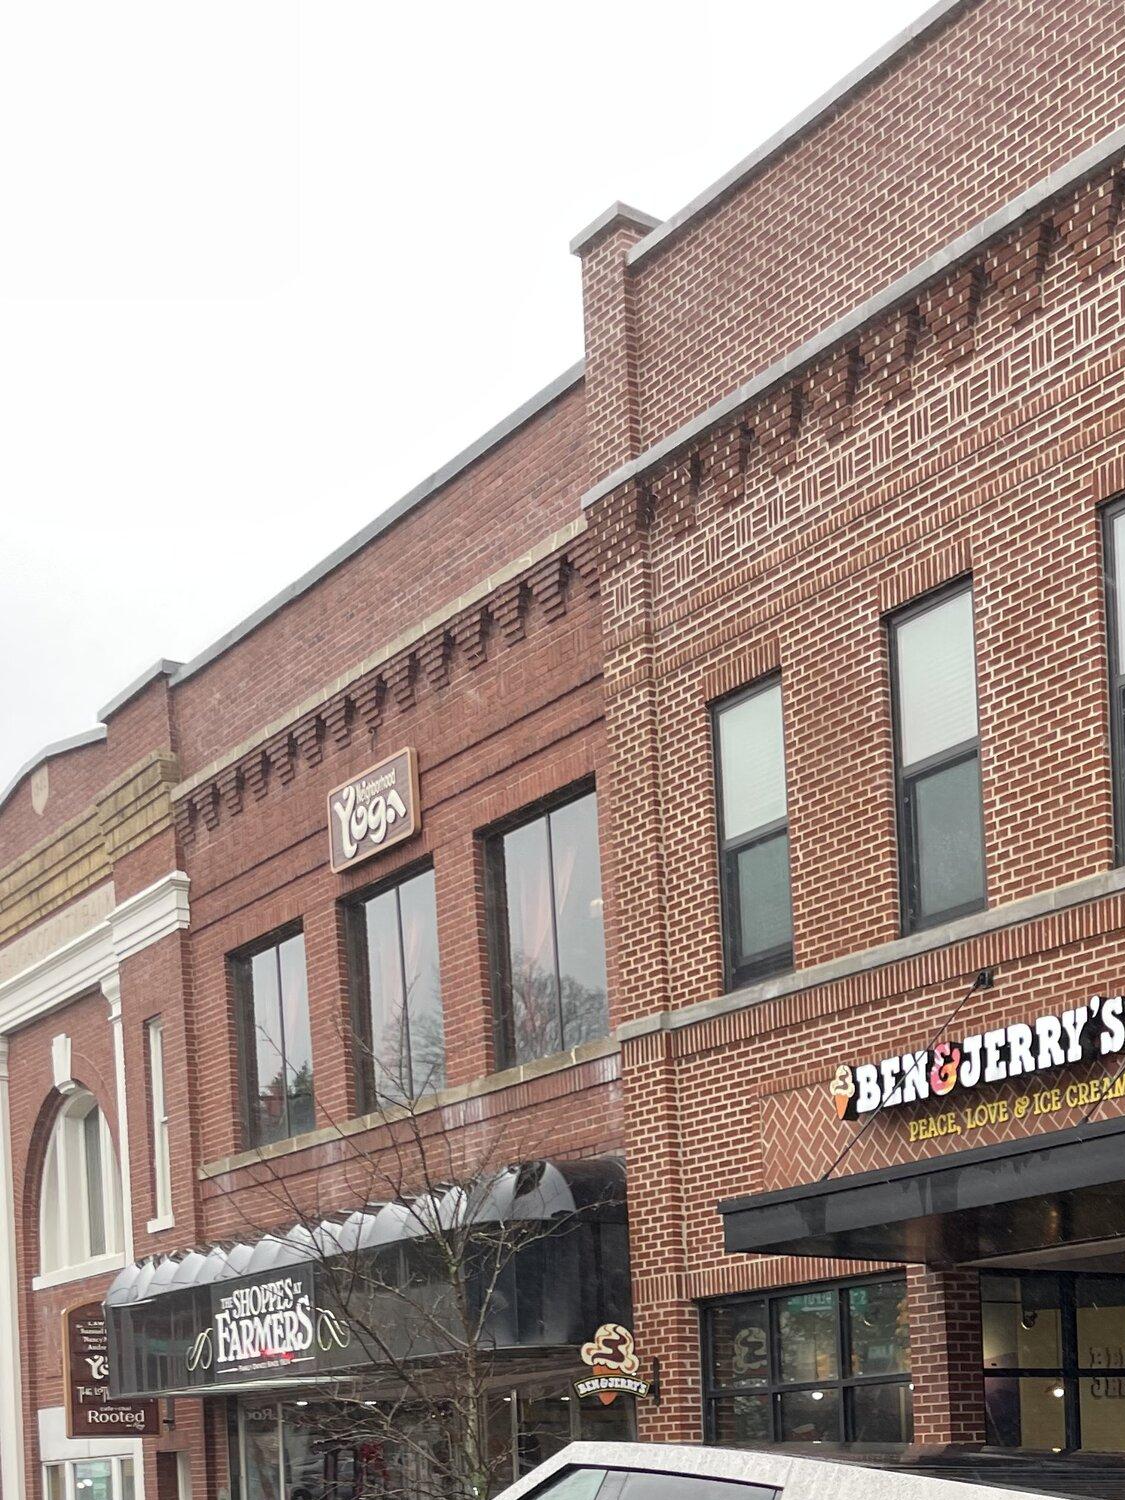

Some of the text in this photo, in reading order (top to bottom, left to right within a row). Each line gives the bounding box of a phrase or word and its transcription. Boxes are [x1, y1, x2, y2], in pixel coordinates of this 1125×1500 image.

[908, 1112, 961, 1142] PEACE,
[966, 1100, 1009, 1130] LOVE
[1013, 1096, 1029, 1119] &
[1033, 1086, 1061, 1116] ICE
[232, 1278, 293, 1319] SHOPPES
[215, 1295, 313, 1363] FARMERS
[88, 1409, 145, 1423] Rooted
